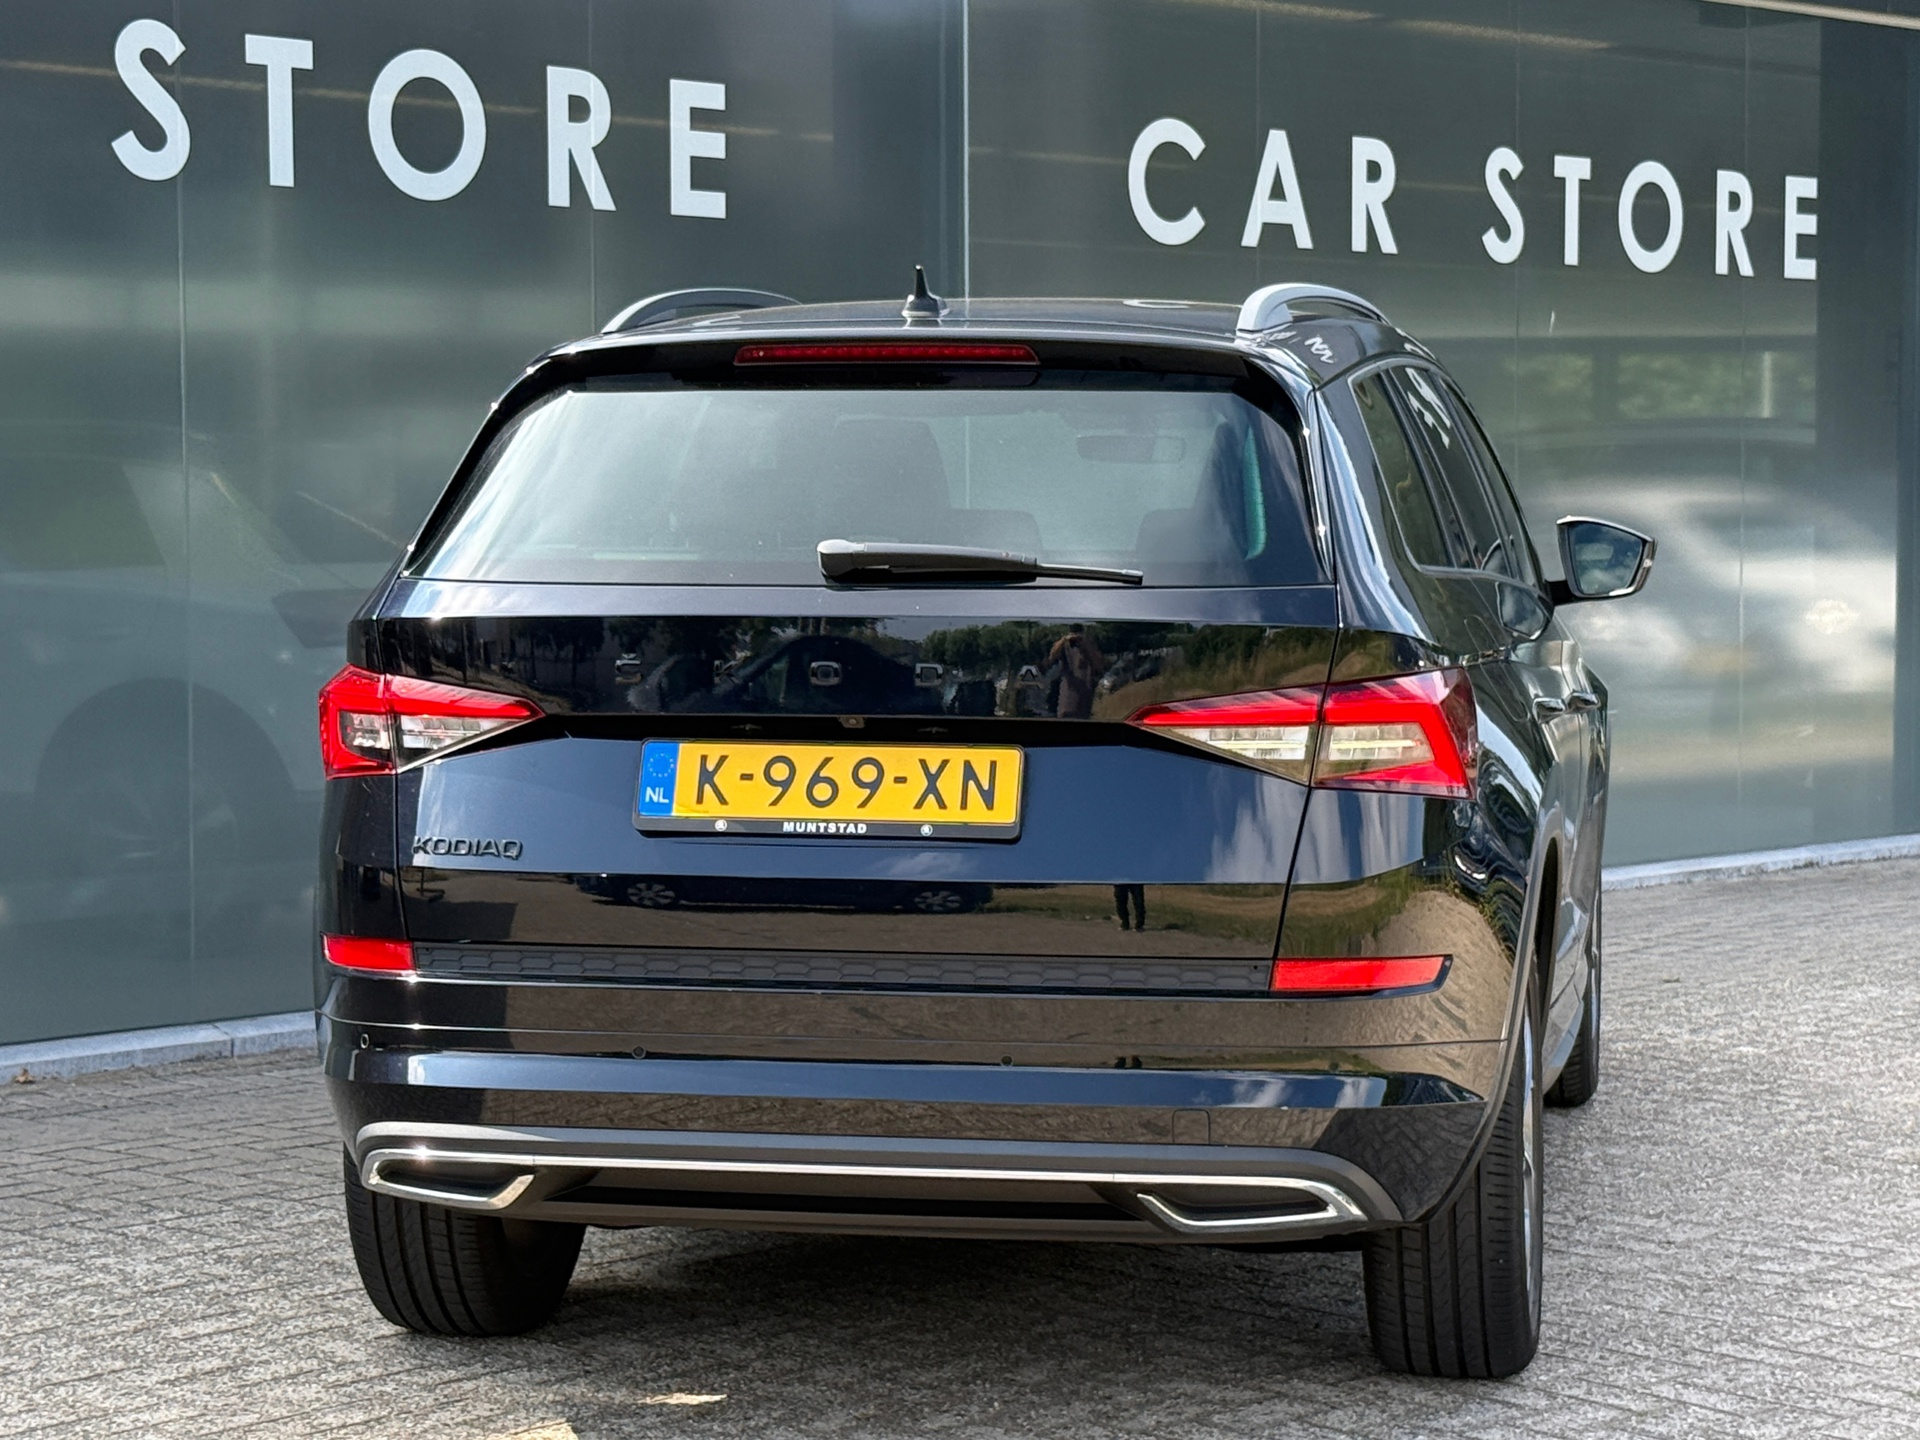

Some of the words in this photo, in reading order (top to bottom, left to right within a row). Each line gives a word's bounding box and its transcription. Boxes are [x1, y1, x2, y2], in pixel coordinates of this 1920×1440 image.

[111, 18, 727, 220] STORE
[1127, 117, 1398, 255] CAR
[1481, 146, 1819, 281] STORE
[645, 786, 670, 804] NL
[695, 754, 998, 811] K-969-XN
[782, 821, 867, 834] MUNTSTAD
[412, 836, 523, 860] KODIAQ
